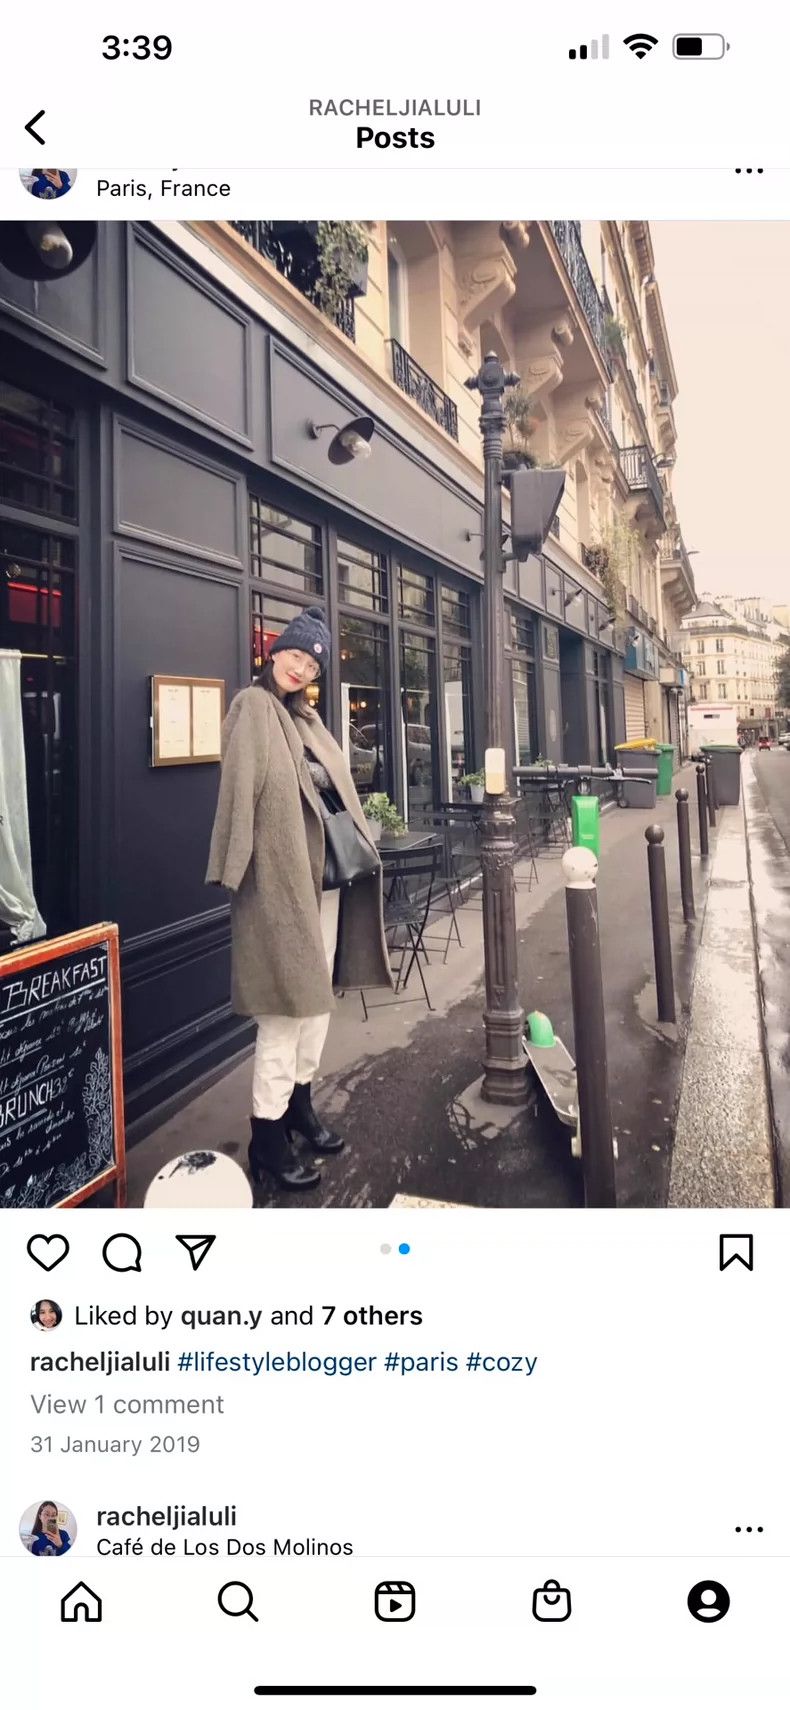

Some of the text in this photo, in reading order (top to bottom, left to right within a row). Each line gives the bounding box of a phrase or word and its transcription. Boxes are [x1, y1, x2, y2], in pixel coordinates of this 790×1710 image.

[101, 34, 173, 61] 3:39
[309, 99, 481, 117] RACHELJIALULI
[356, 126, 436, 150] Posts
[97, 179, 231, 201] Paris, France
[1, 956, 107, 1013] BREAKFAST
[75, 1305, 423, 1331] Liked by quan.y and 7 others
[30, 1351, 538, 1377] racheljialuli #lifestyleblogger #paris #cozy
[30, 1394, 225, 1415] View 1 comment
[30, 1436, 200, 1458] 31 January 2019
[97, 1505, 237, 1530] racheljialuli
[96, 1537, 354, 1556] Café de Los Dos Molinos
